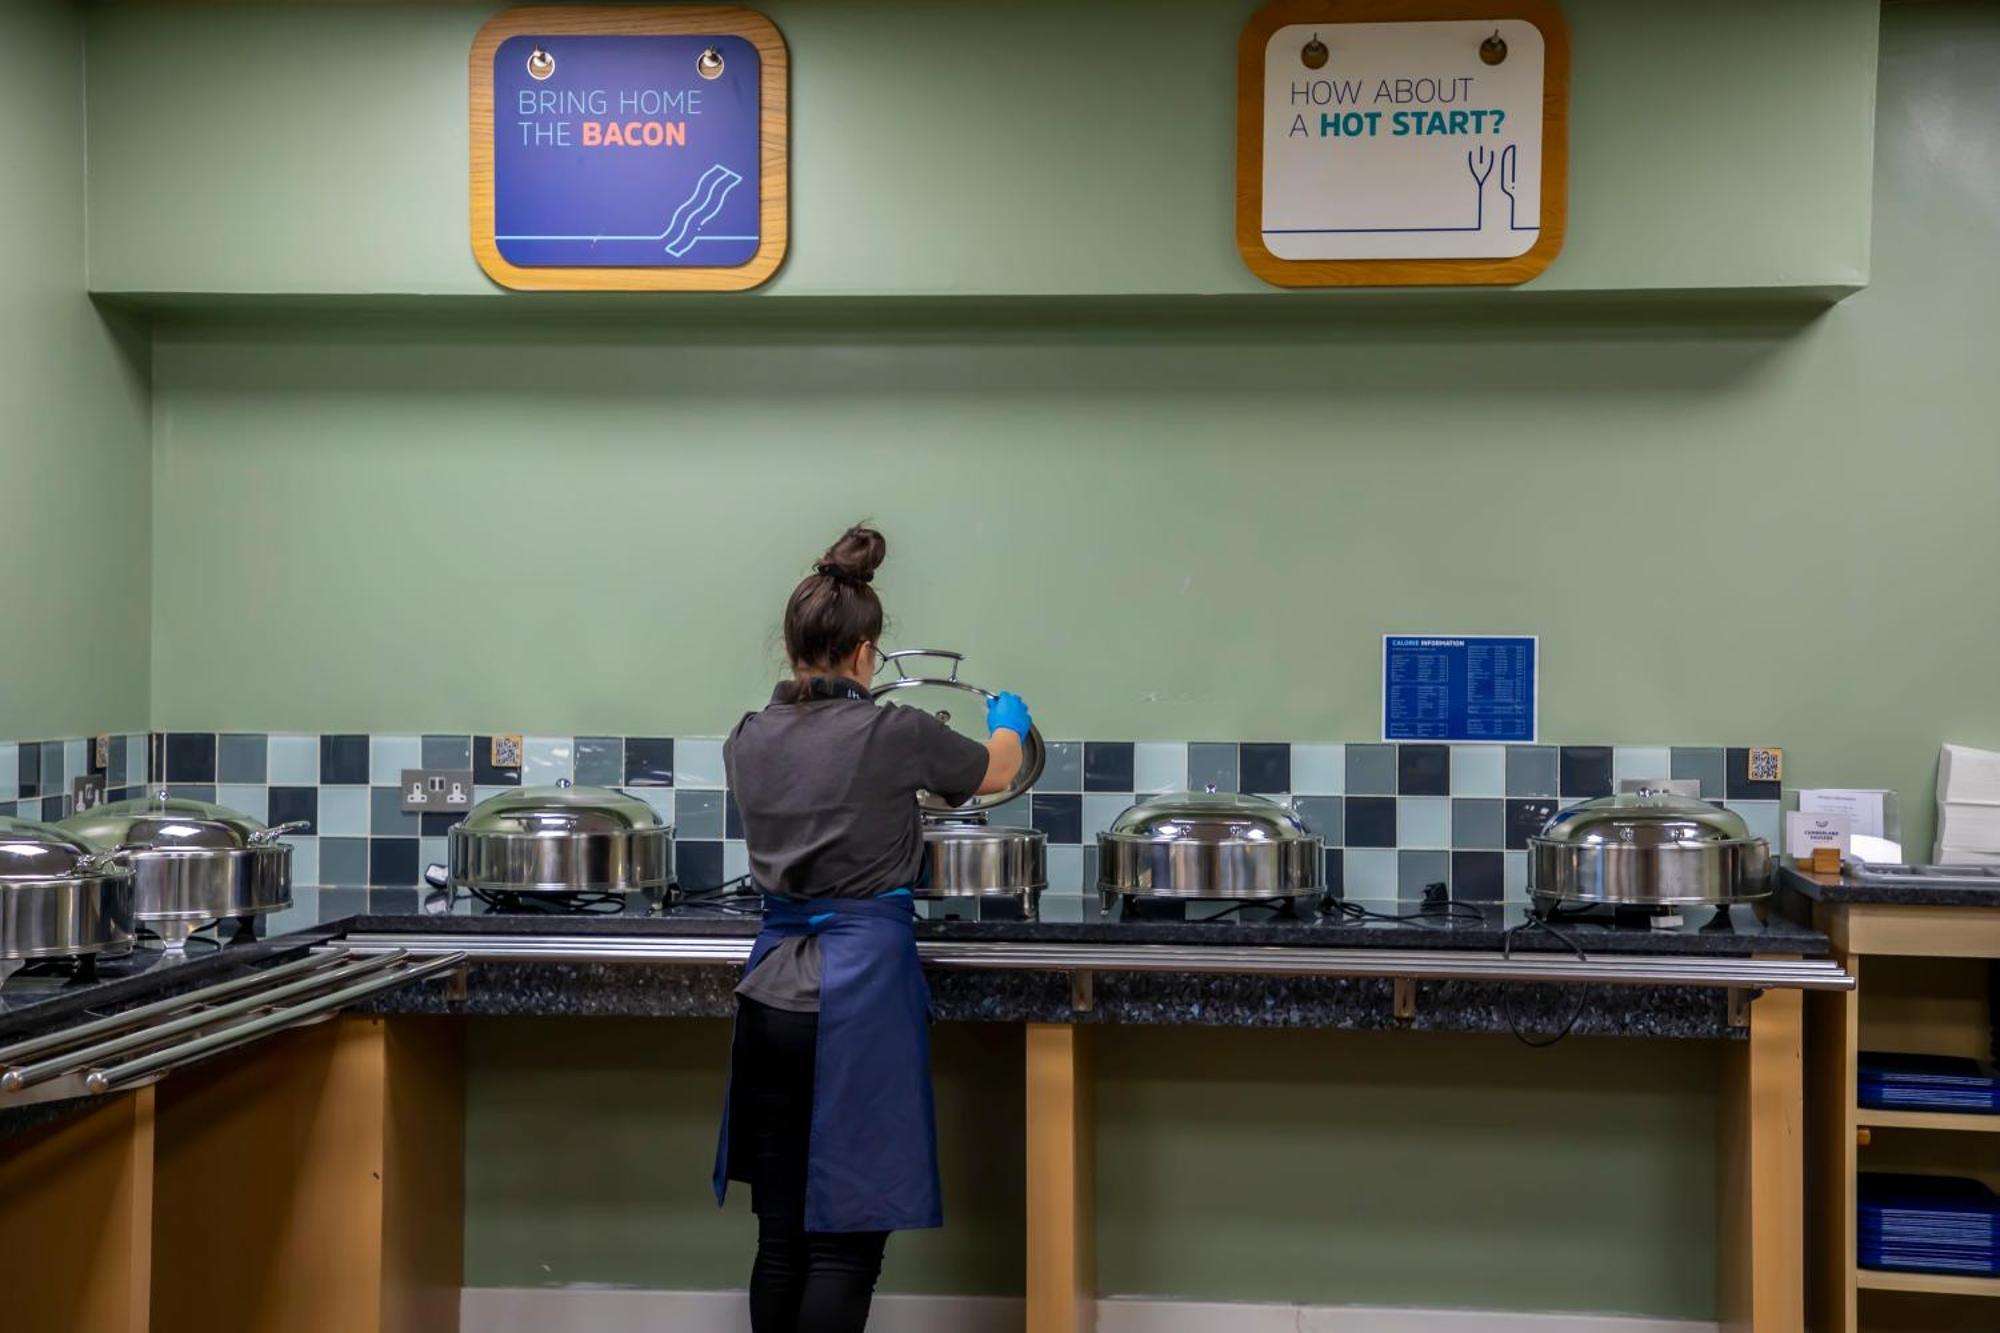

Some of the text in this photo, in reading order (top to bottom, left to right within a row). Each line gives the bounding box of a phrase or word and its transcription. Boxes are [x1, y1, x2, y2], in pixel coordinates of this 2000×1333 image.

[519, 90, 702, 115] BRING HOME
[1291, 78, 1474, 105] HOW ABOUT
[518, 121, 686, 146] THE BACON
[1289, 110, 1505, 138] A HOT START?
[1392, 639, 1465, 647] CALORIE INFORMATION
